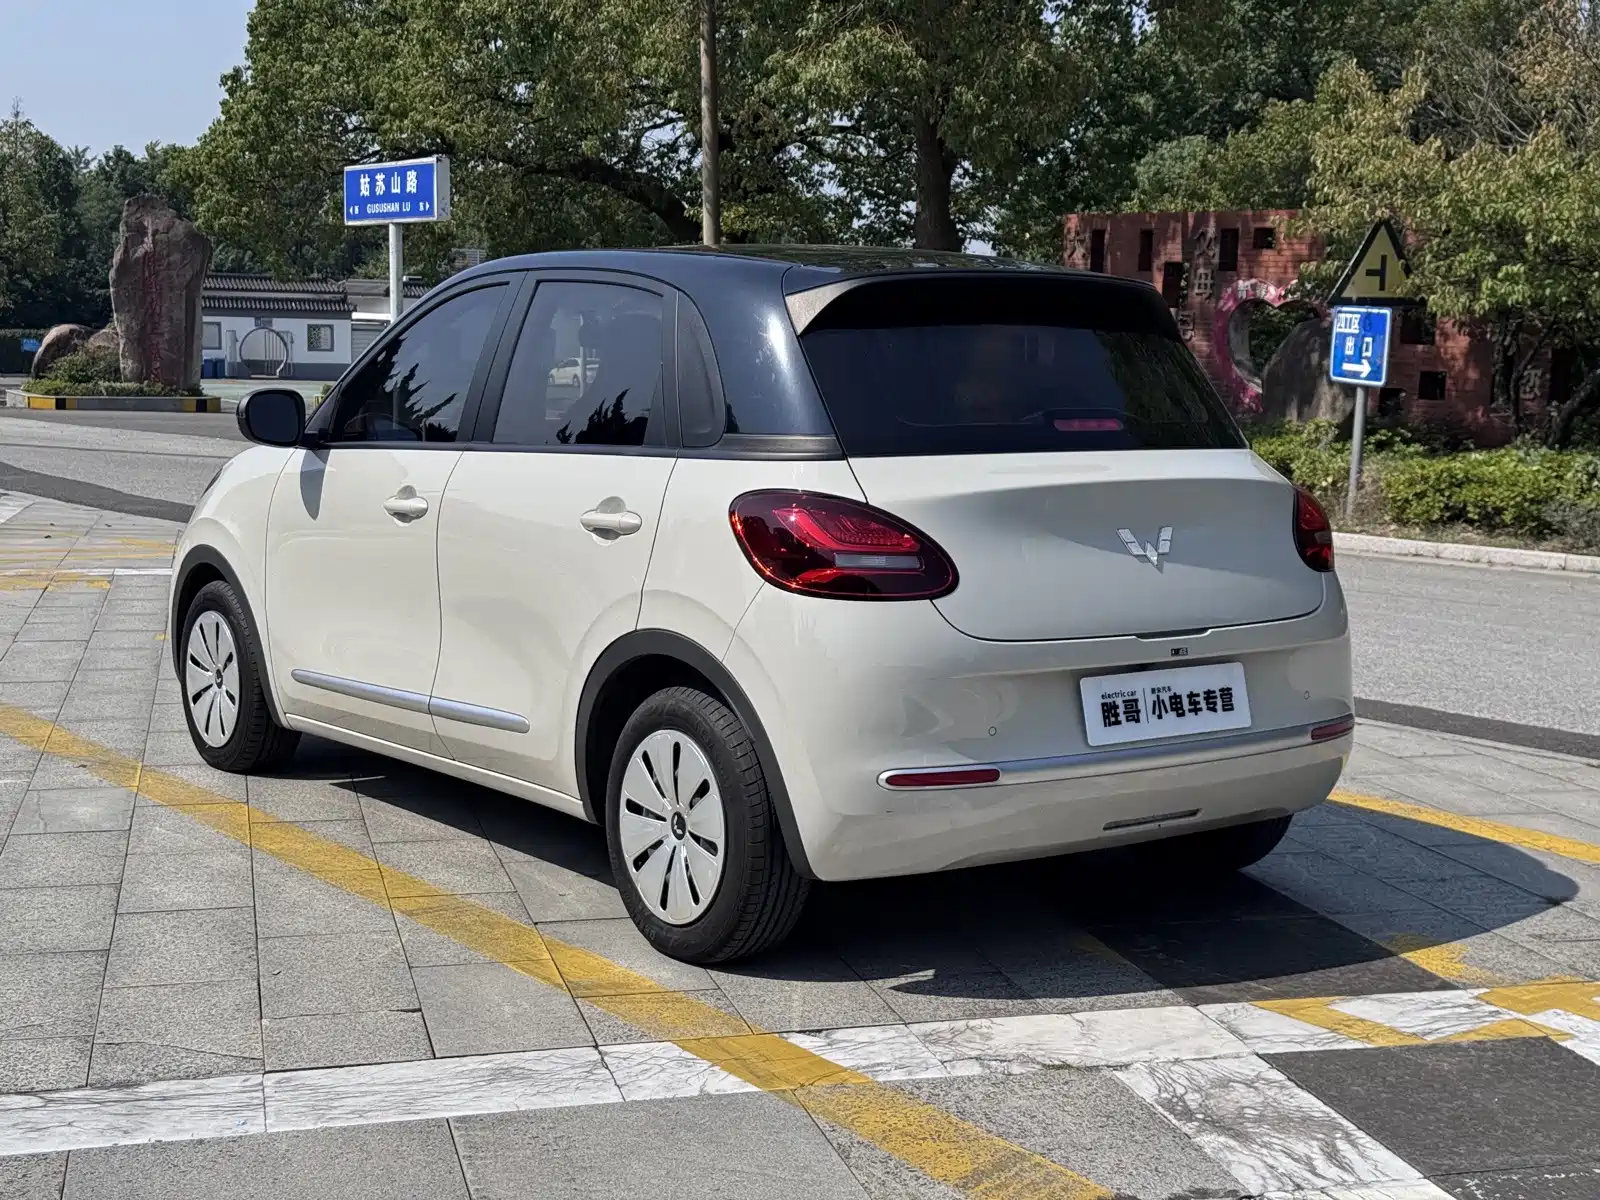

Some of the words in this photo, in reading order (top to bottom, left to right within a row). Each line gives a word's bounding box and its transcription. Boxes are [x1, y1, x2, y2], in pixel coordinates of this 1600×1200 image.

[359, 169, 418, 197] 姑苏山路
[366, 201, 400, 214] GUSUSHAN
[402, 201, 411, 212] LU
[1344, 336, 1373, 357] 出口
[1100, 689, 1127, 700] electric
[1127, 689, 1137, 697] car
[1151, 686, 1235, 720] 小电车专营
[1101, 698, 1141, 728] 胜哥
